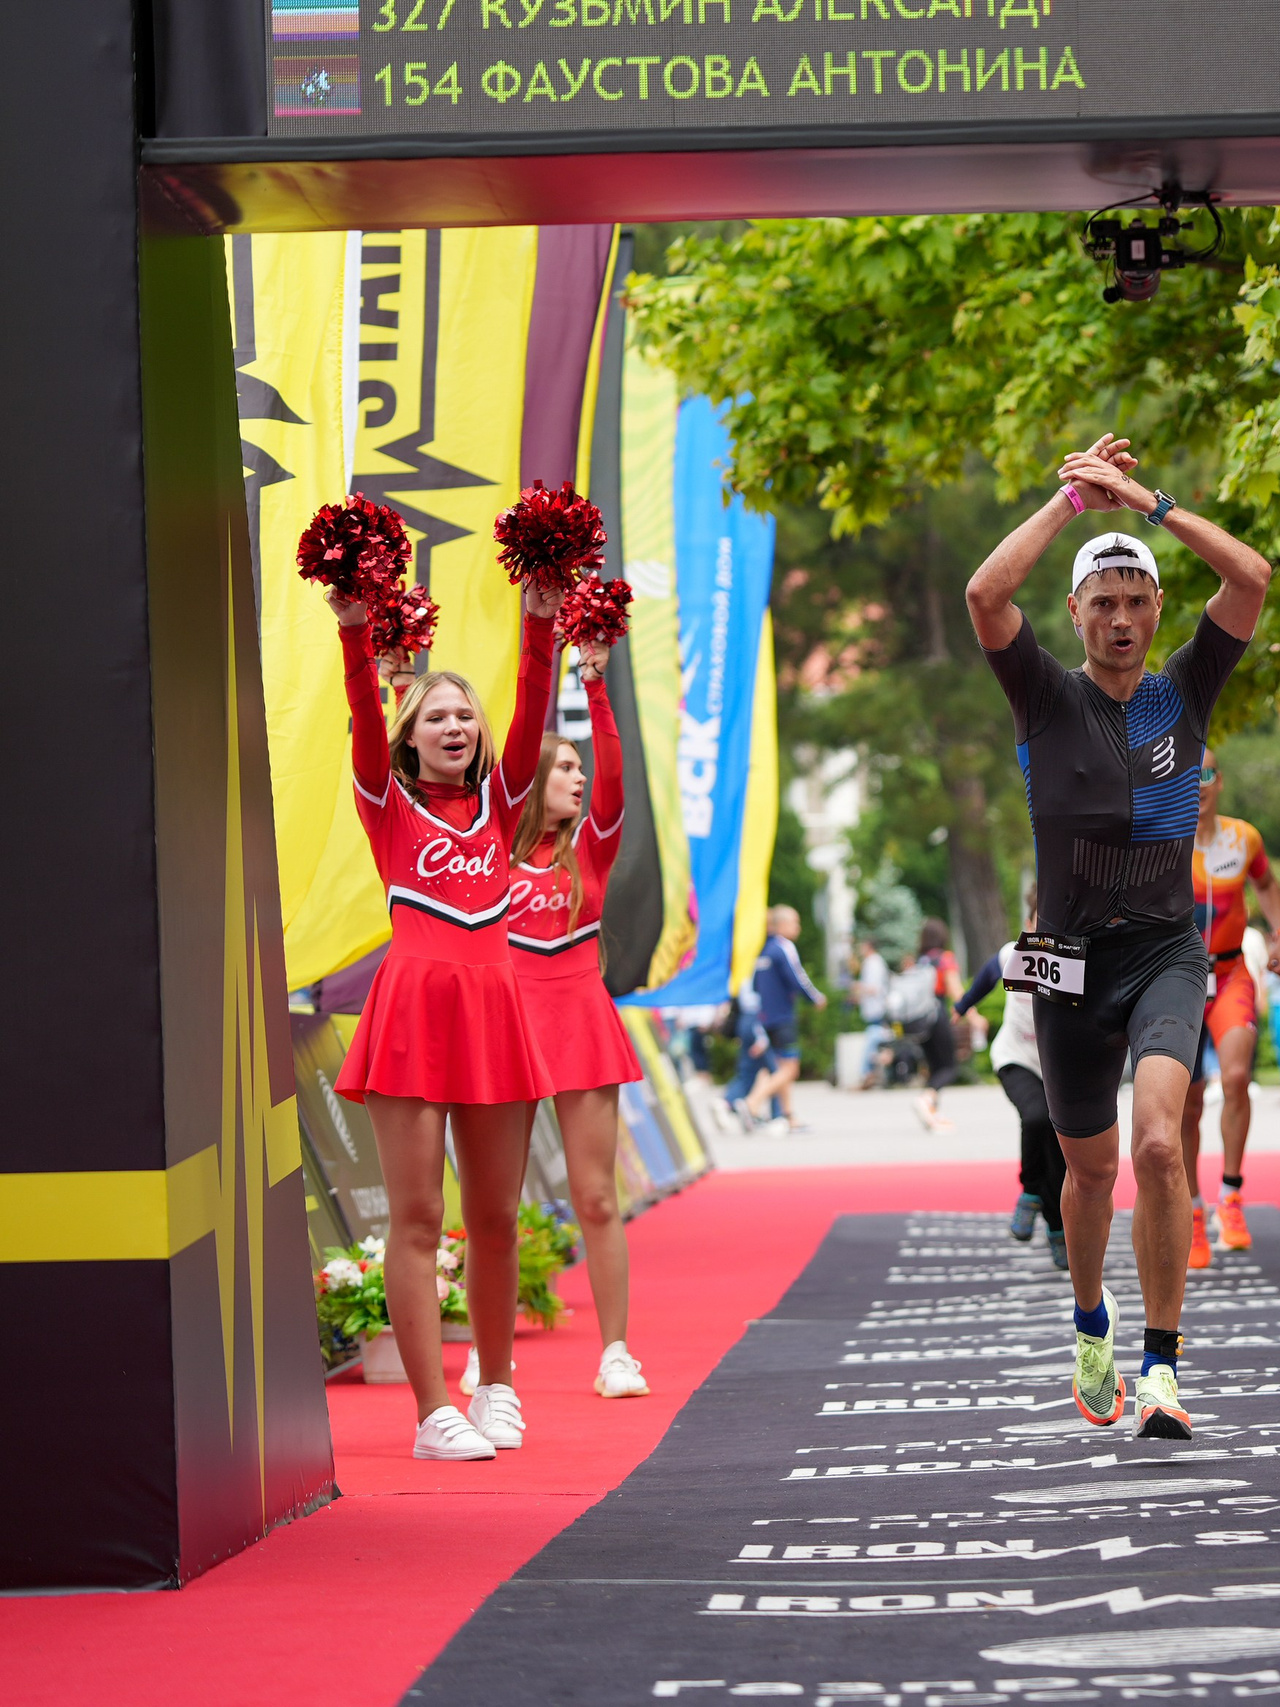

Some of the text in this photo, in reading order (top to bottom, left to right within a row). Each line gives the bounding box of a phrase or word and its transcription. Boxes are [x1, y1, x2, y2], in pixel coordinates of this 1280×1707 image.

[374, 61, 464, 106] 154
[481, 54, 771, 104] ФАУСТОВА
[787, 46, 1087, 96] АНТОНИНА
[416, 837, 496, 878] Cool
[1021, 955, 1061, 985] 206
[1037, 985, 1051, 996] DENIS
[821, 1395, 1036, 1412] IRON
[787, 1457, 1037, 1479] IRON
[737, 1538, 1036, 1559] IRON
[706, 1588, 1036, 1612] IRON
